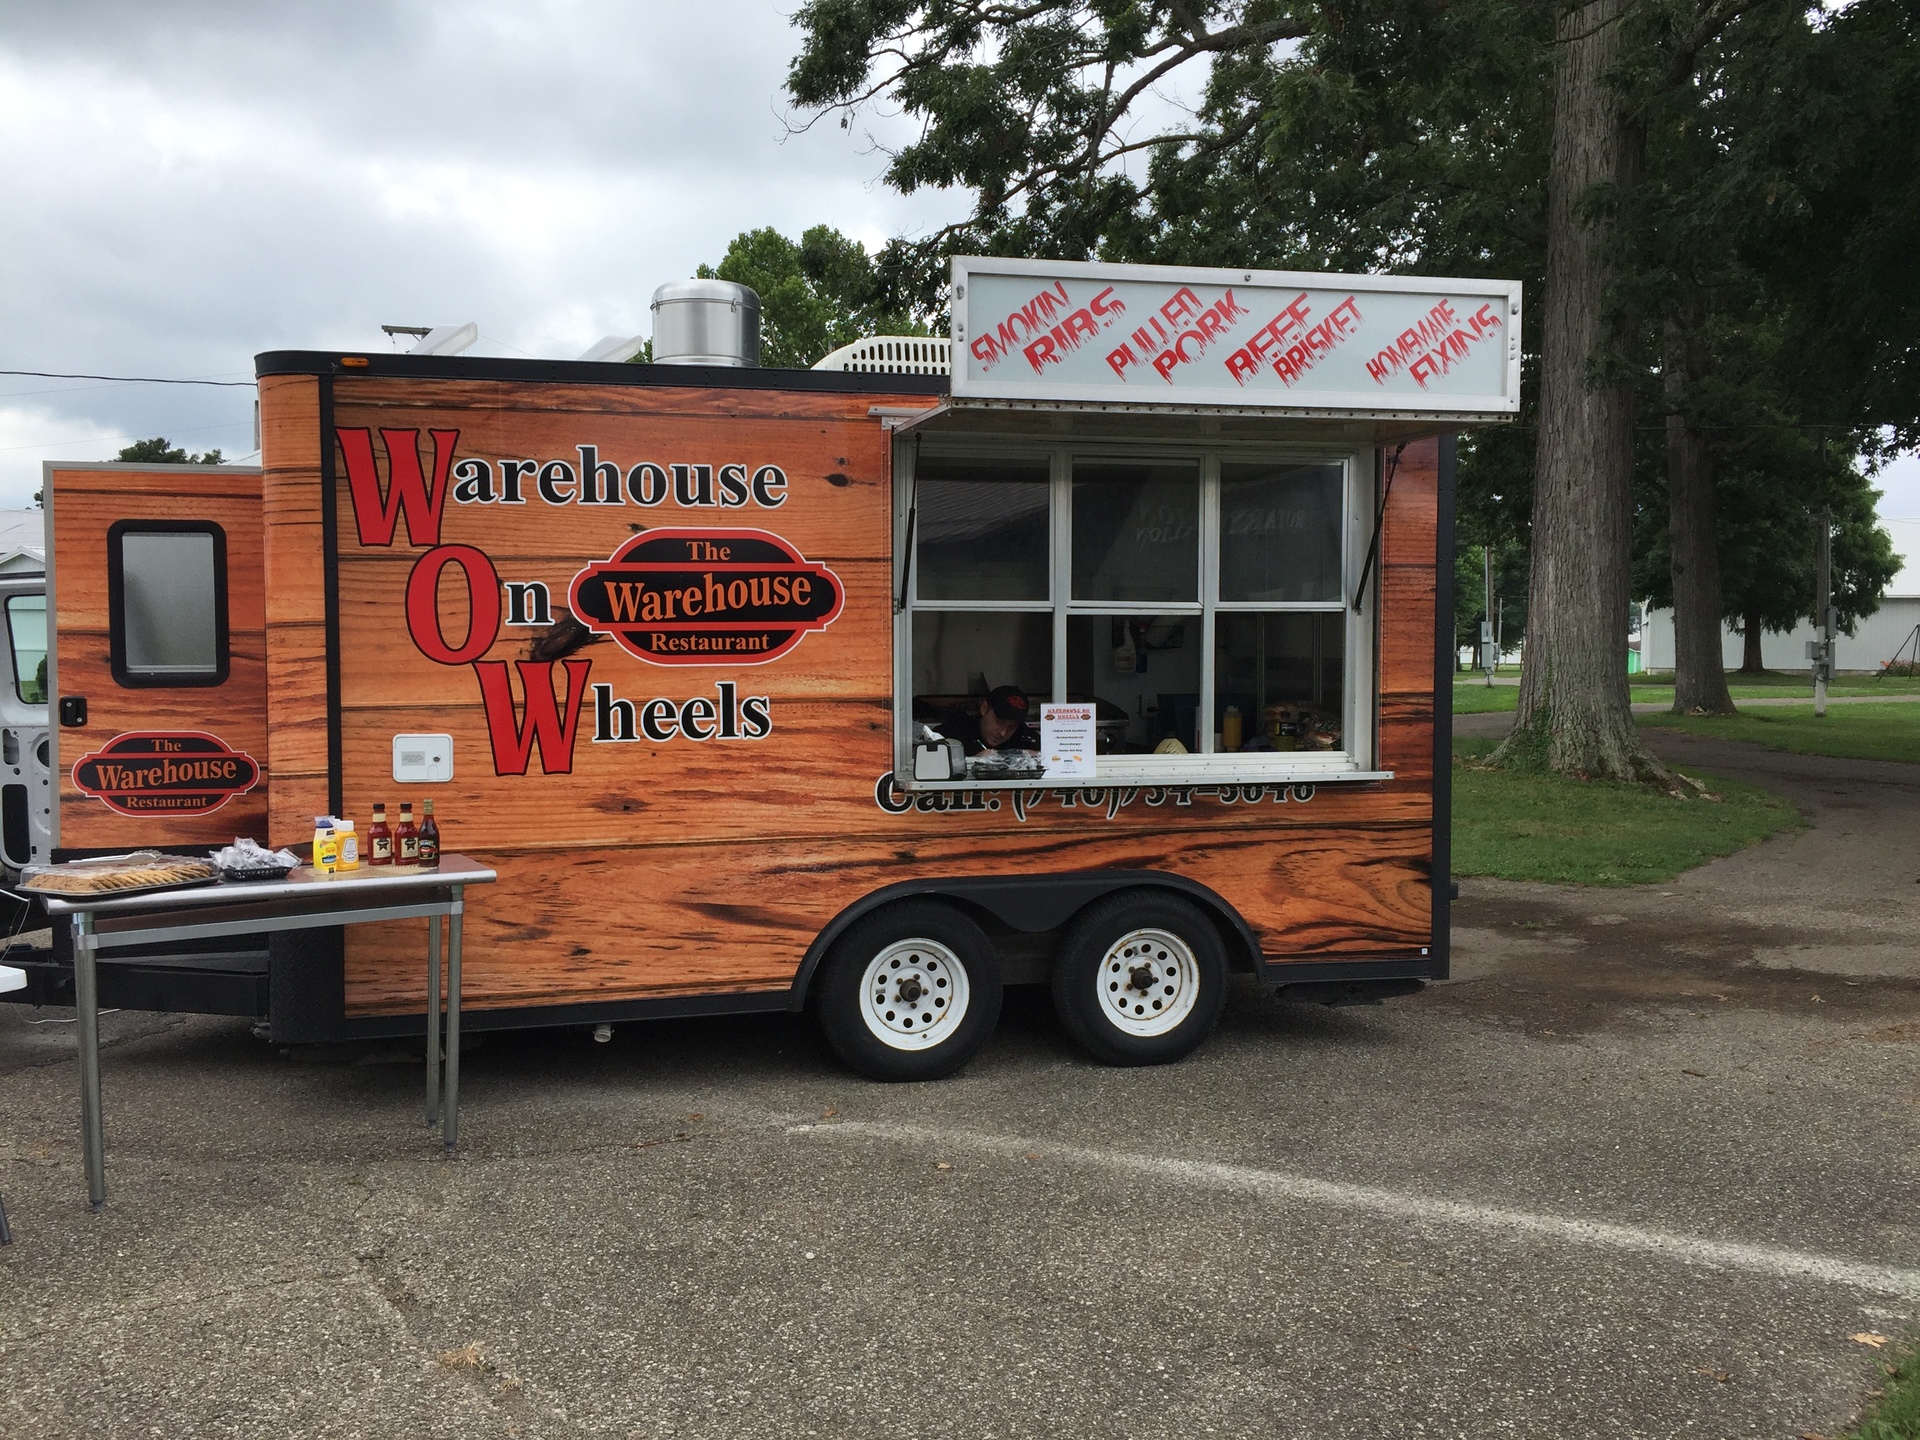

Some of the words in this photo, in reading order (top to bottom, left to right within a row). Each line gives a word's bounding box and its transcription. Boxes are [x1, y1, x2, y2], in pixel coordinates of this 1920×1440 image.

[970, 280, 1073, 372] SMOKIN
[1023, 286, 1126, 376] RIBS
[1106, 286, 1203, 383] PULLED
[1152, 288, 1250, 386] PORK
[1224, 292, 1311, 388] BEEF
[1272, 295, 1366, 389] BRISKET
[1365, 298, 1461, 386] HOMEMADE
[1408, 303, 1503, 392] FIXINS
[335, 427, 789, 547] Warehouse
[686, 541, 731, 561] The
[405, 543, 556, 666] On
[604, 571, 812, 622] Warehouse
[651, 633, 770, 651] Restaurant
[151, 739, 182, 752] The
[471, 658, 772, 776] Wheels
[96, 757, 237, 790] Warehouse
[126, 795, 207, 808] Restaurant
